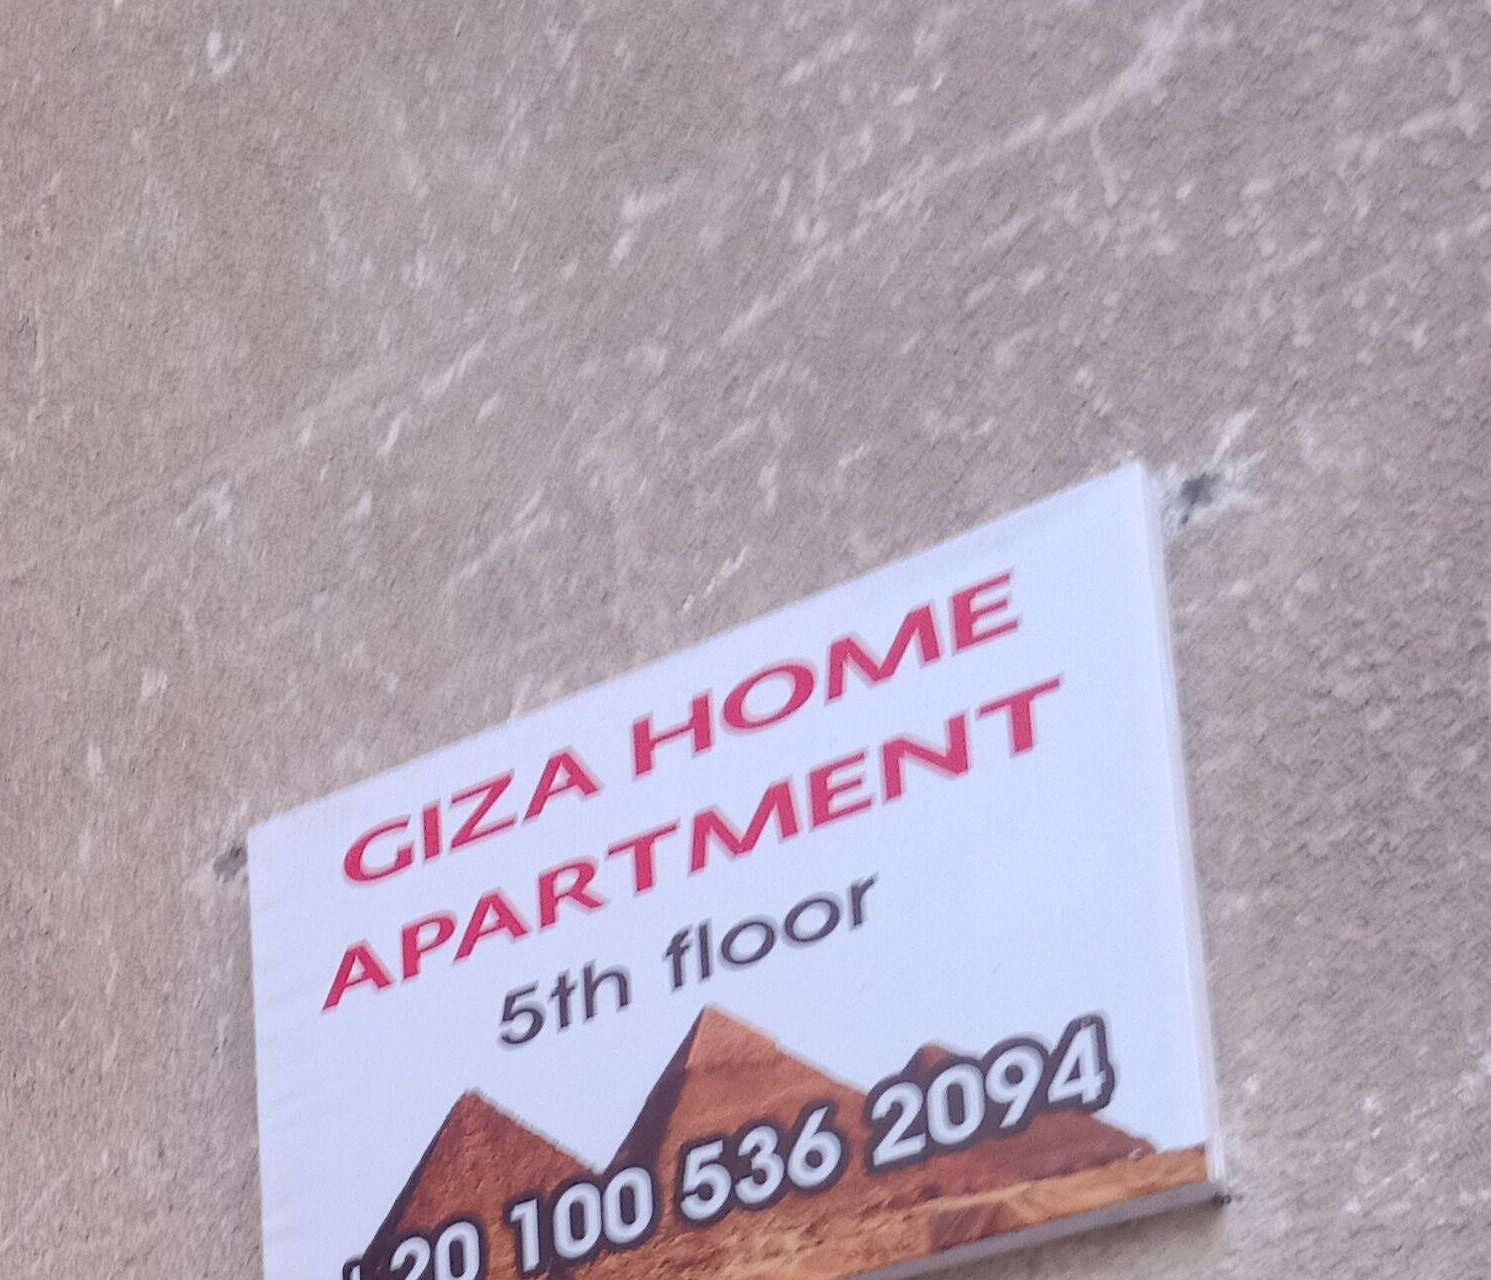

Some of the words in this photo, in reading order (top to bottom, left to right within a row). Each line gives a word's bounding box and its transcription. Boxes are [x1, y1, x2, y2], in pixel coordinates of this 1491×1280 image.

[321, 675, 1062, 1013] APARTMENT
[342, 747, 600, 884] GIZA
[630, 569, 1021, 777] HOME
[497, 961, 632, 1049] 5th
[665, 874, 878, 992] floor
[509, 1165, 655, 1276] 100
[681, 1107, 843, 1220] 536
[871, 1014, 1110, 1166] 2094
